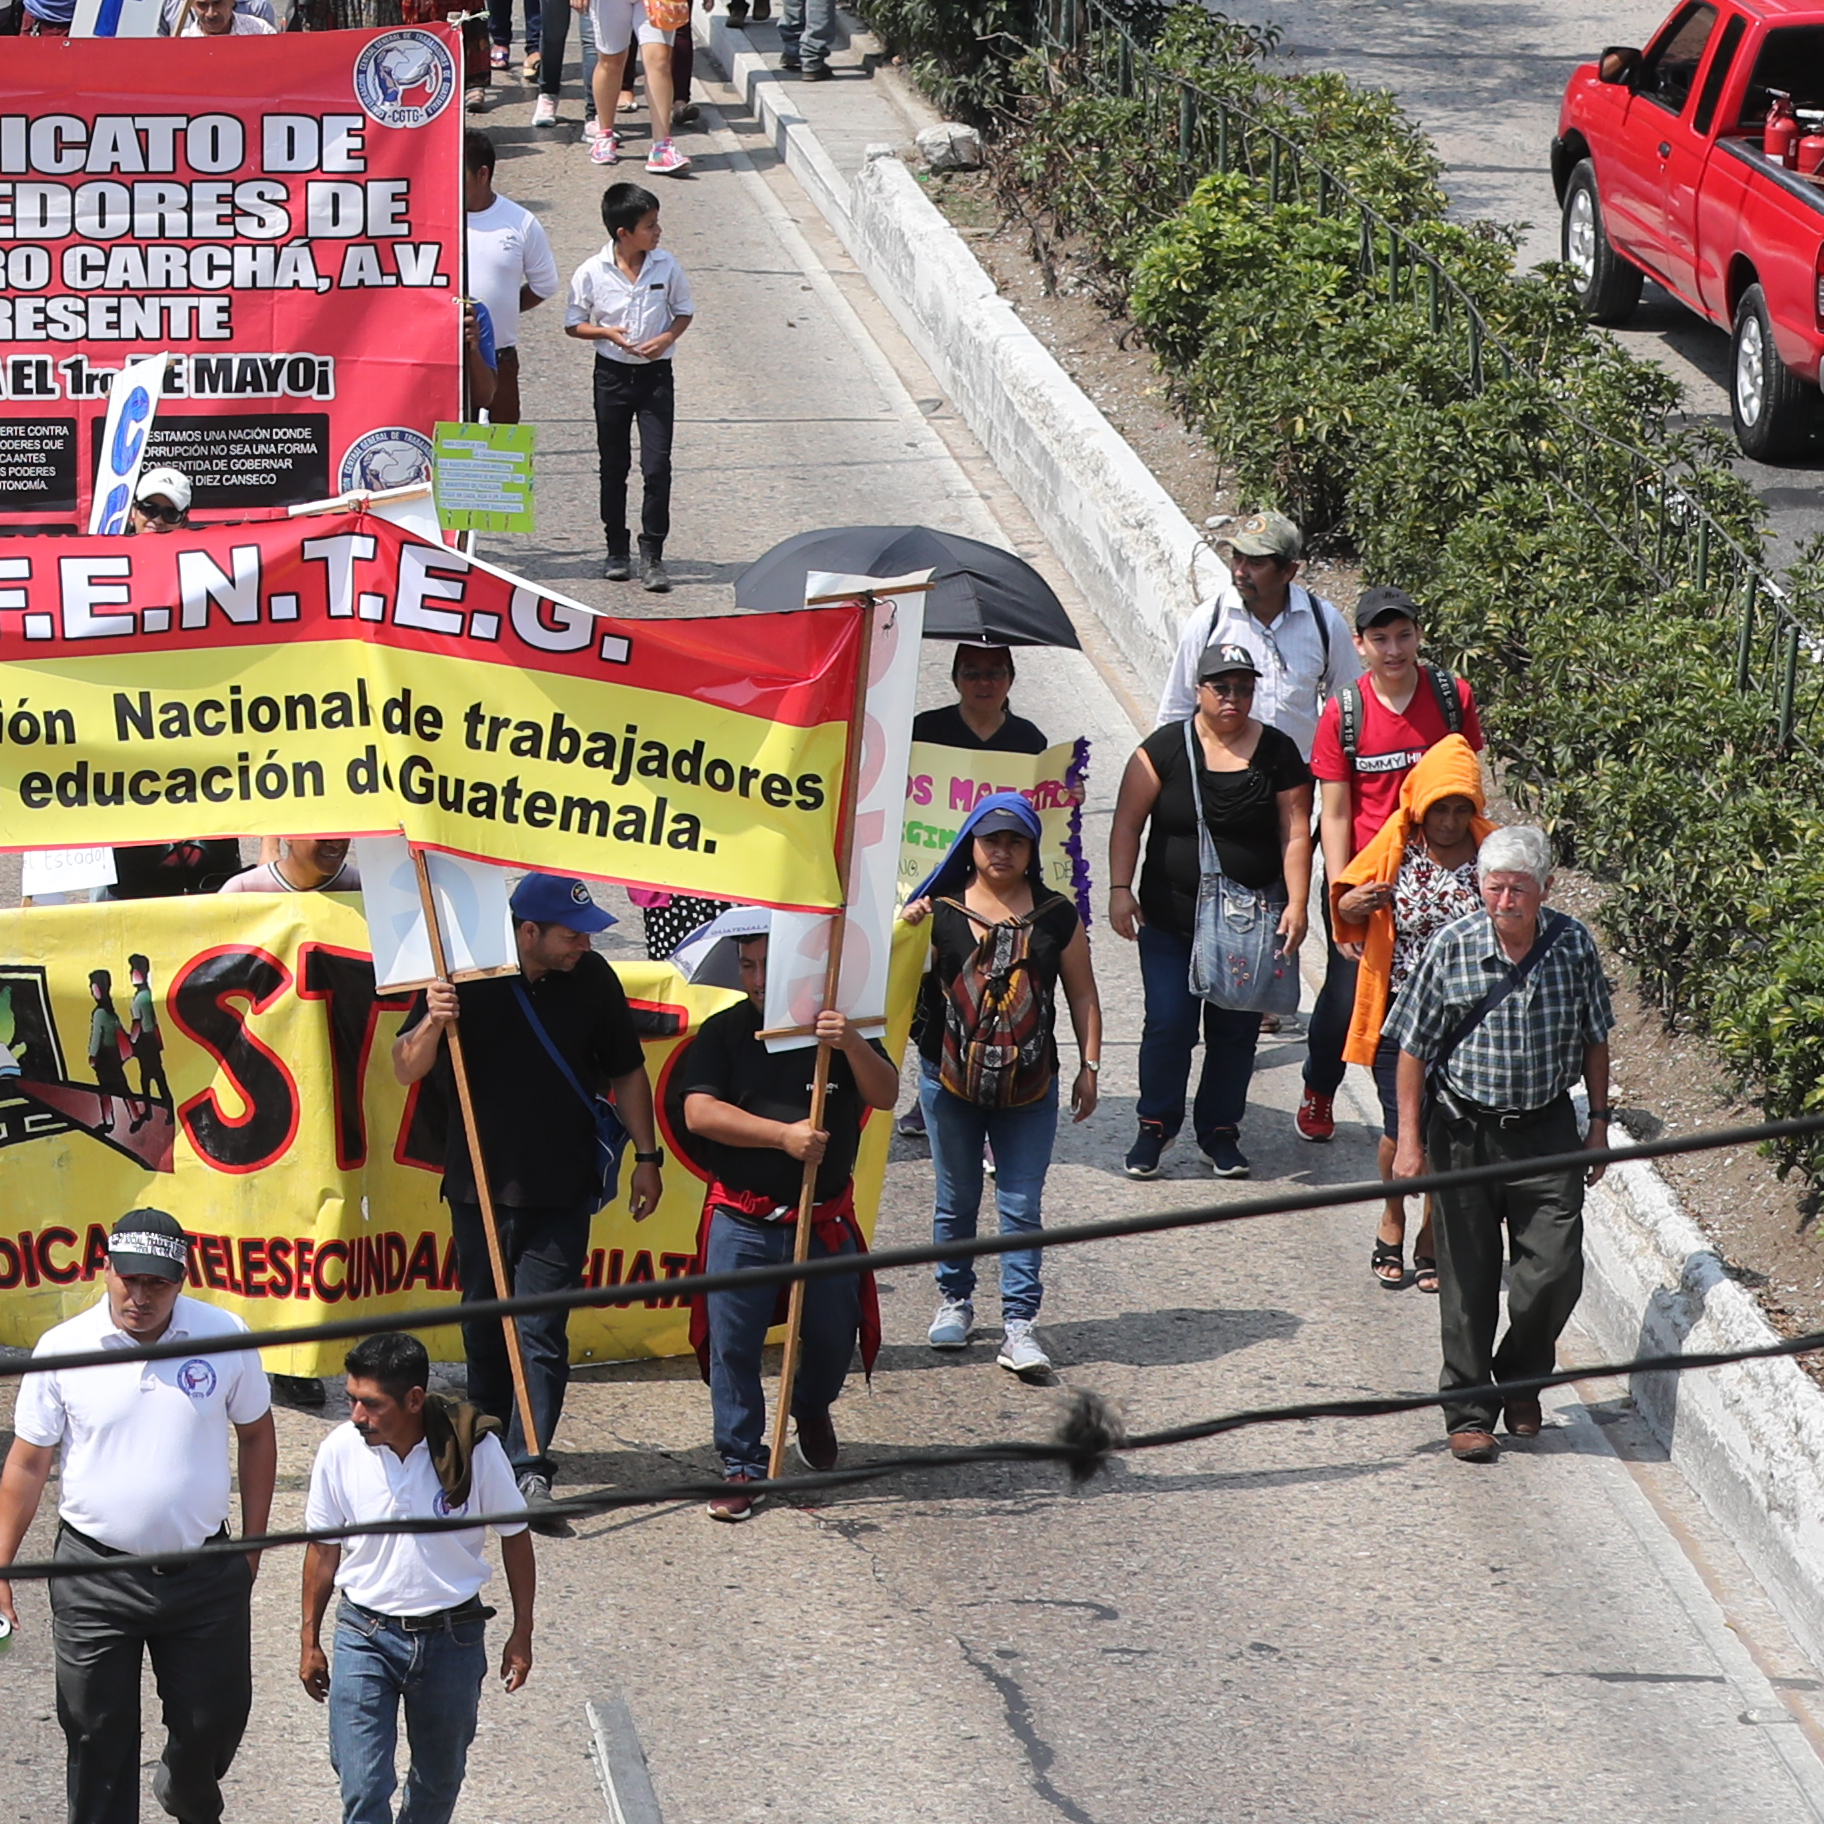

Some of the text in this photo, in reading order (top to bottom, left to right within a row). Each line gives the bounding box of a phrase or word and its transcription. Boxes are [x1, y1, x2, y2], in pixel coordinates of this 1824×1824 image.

[262, 113, 367, 173] DE
[306, 179, 411, 238] DE
[61, 237, 333, 292] CARCHÁ,
[340, 243, 450, 288] A.V.
[13, 359, 56, 396] EL
[27, 425, 69, 436] CONTRA
[43, 439, 64, 450] QUE
[8, 466, 56, 477] PODERES
[114, 676, 371, 741] Nacional
[383, 684, 443, 740] de
[464, 699, 827, 814] trabajadores
[17, 744, 328, 810] educación
[401, 754, 719, 856] Guatemala.
